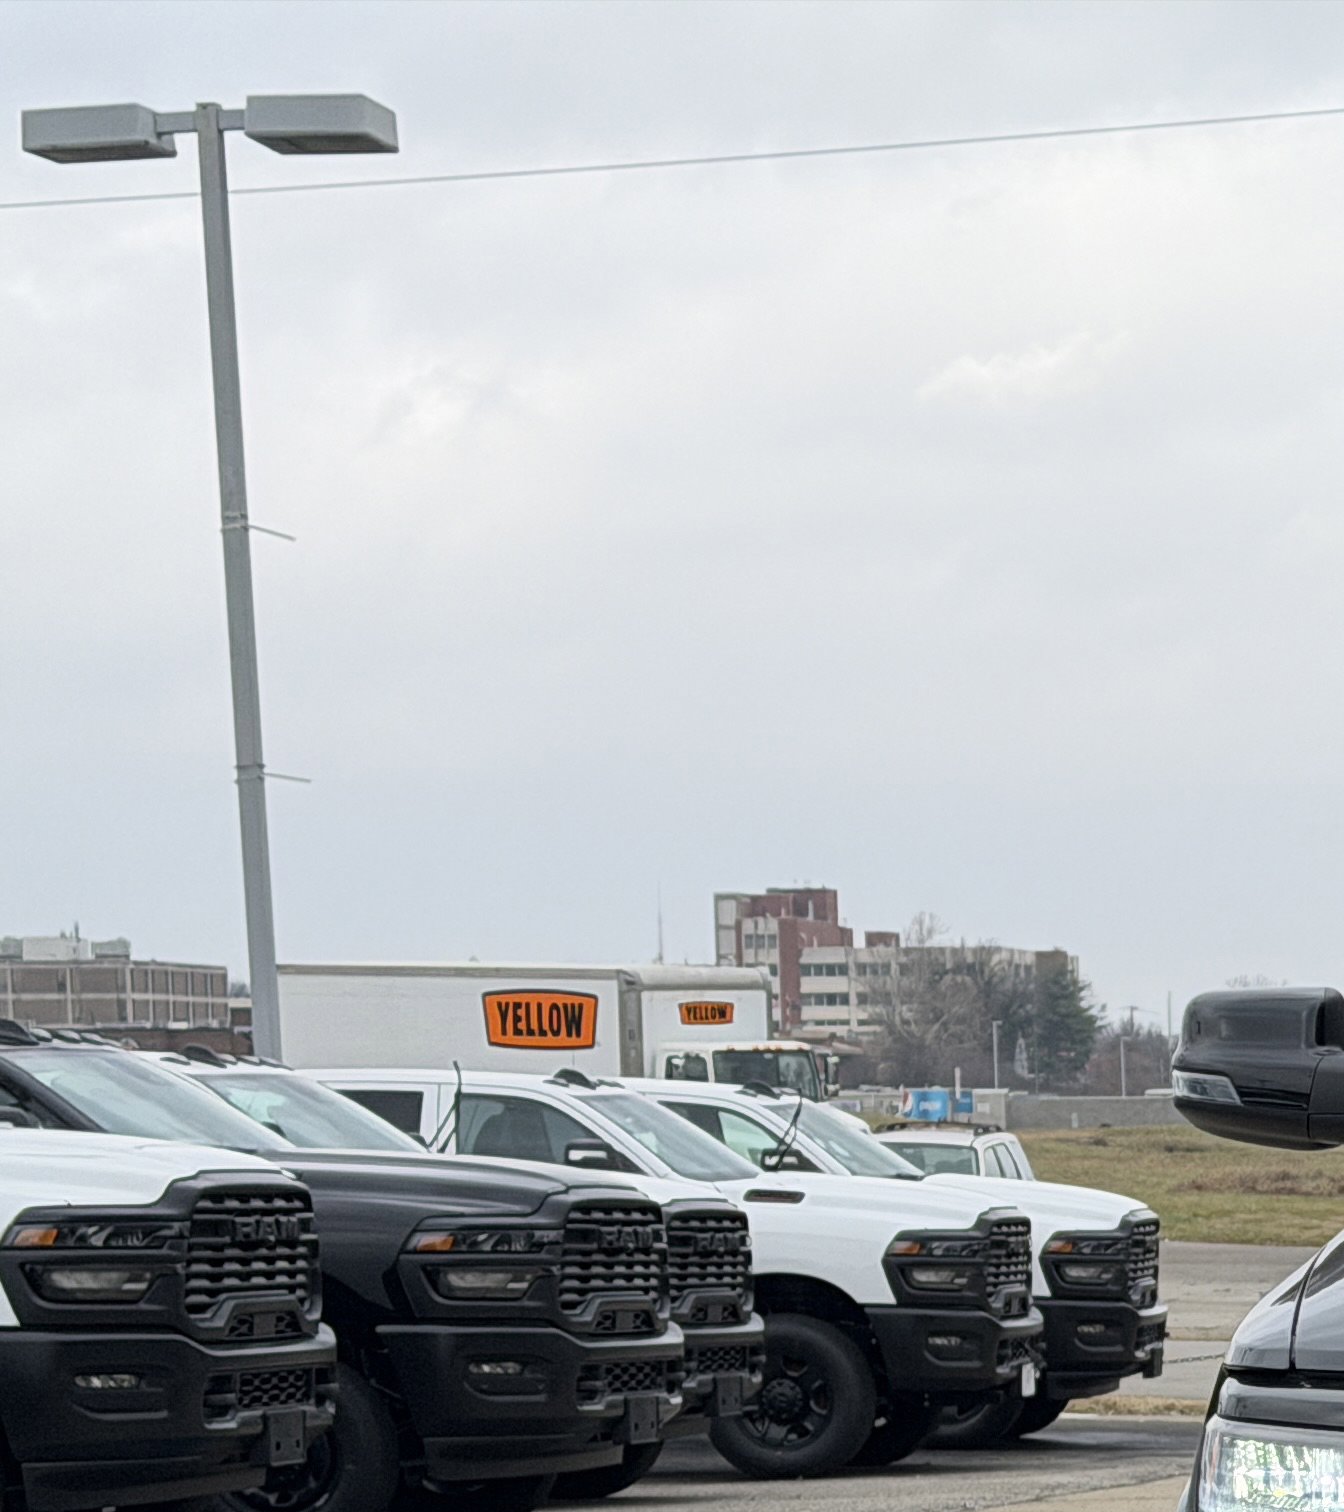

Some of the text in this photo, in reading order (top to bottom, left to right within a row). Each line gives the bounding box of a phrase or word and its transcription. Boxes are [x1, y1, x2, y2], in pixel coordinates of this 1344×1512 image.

[497, 1001, 584, 1038] YELLOW
[684, 1005, 728, 1021] YELLOW
[233, 1214, 298, 1241] RAM
[599, 1227, 653, 1248] RAM
